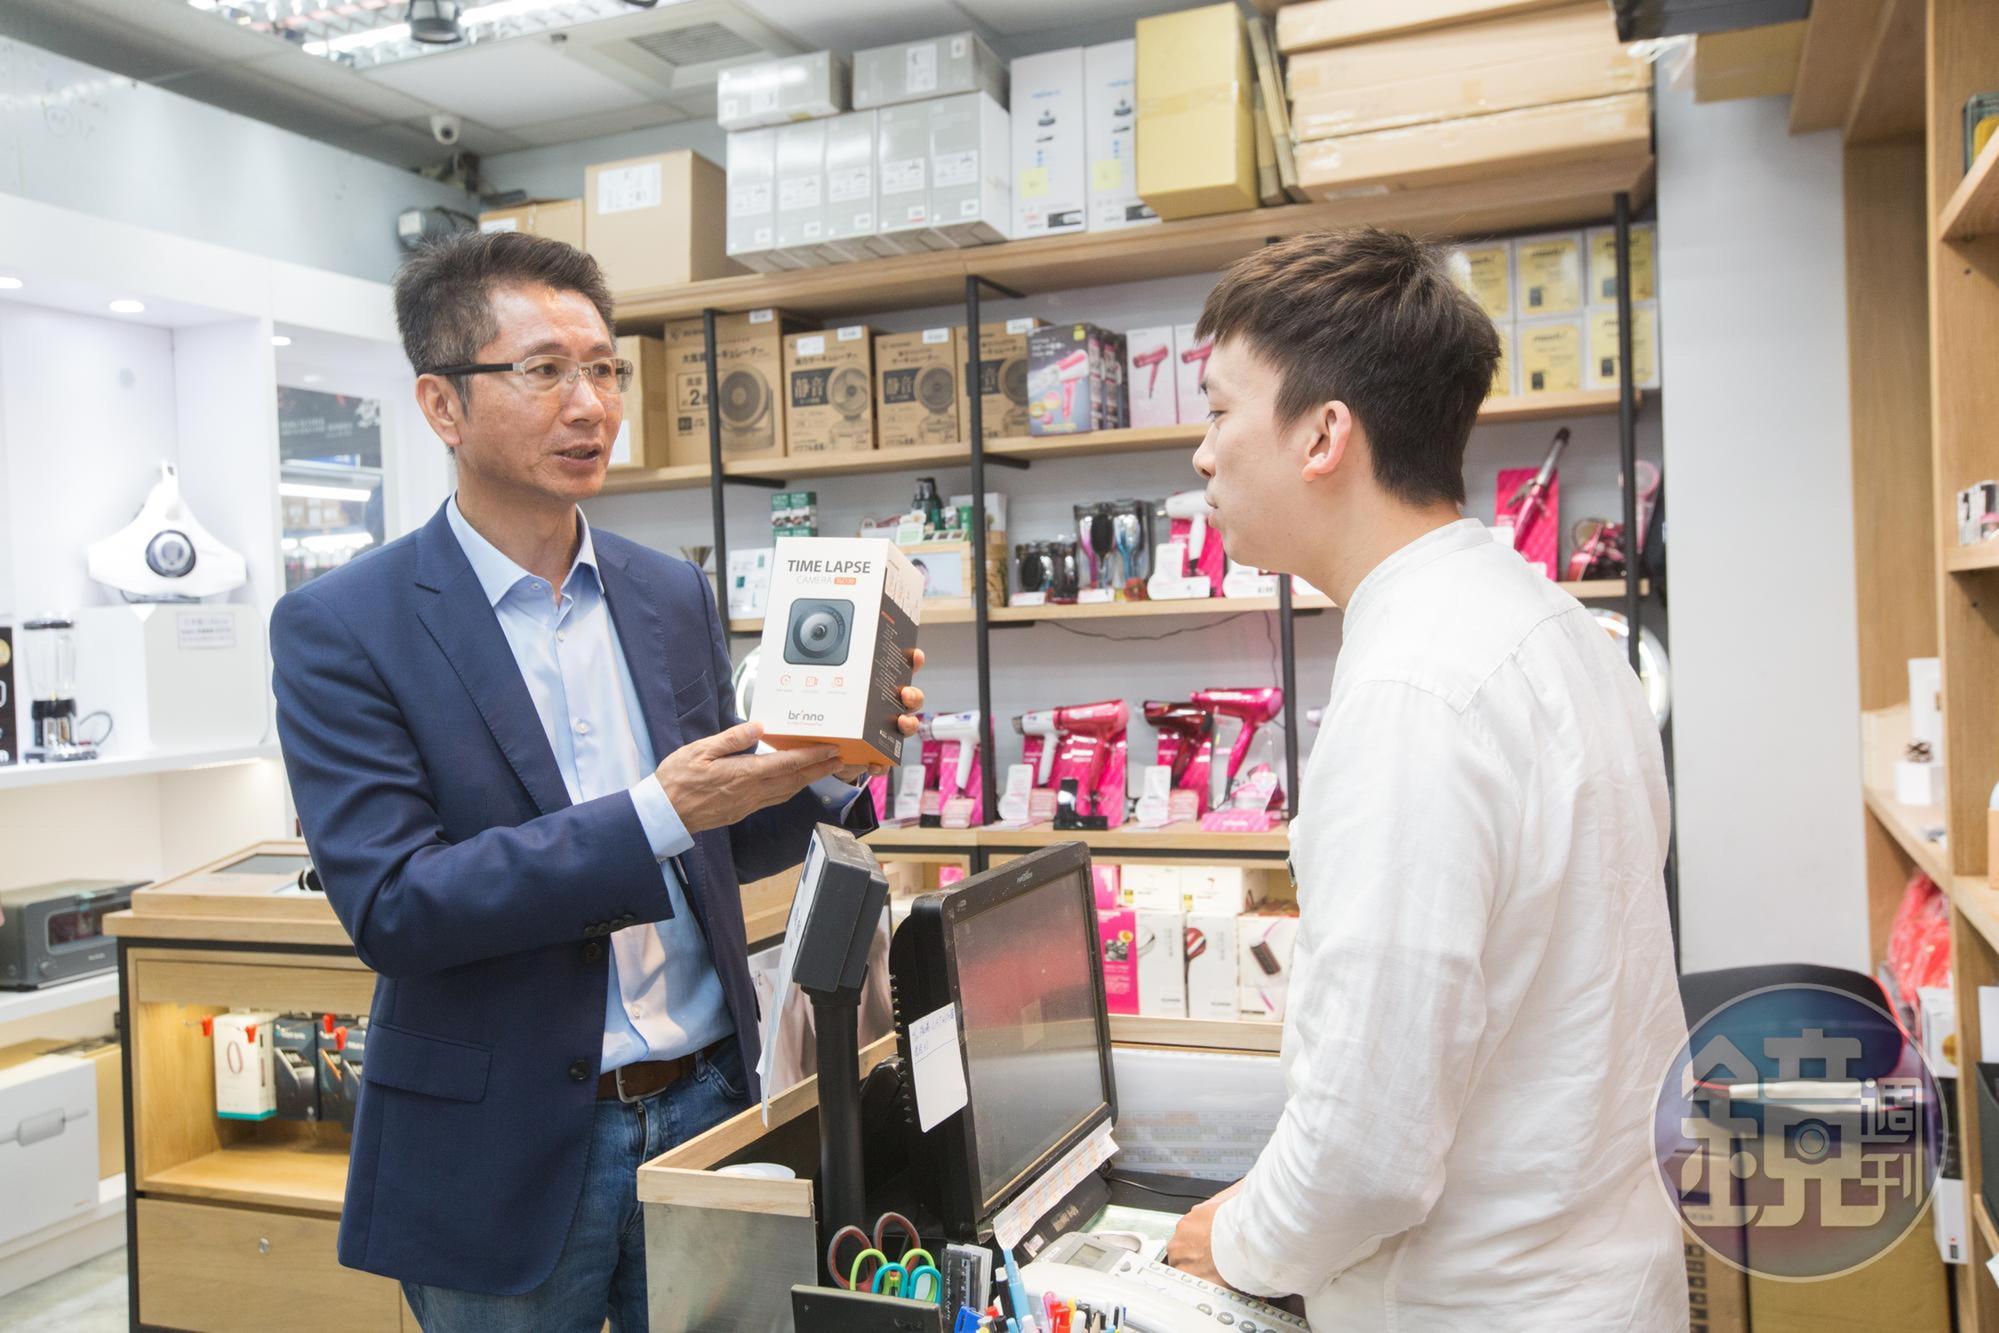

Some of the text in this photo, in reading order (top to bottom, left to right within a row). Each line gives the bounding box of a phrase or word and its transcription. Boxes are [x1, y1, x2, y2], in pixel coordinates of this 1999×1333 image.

[787, 560, 822, 573] TIME
[825, 560, 871, 574] LAPSE
[796, 576, 832, 585] CAMERA
[788, 709, 824, 721] brinno
